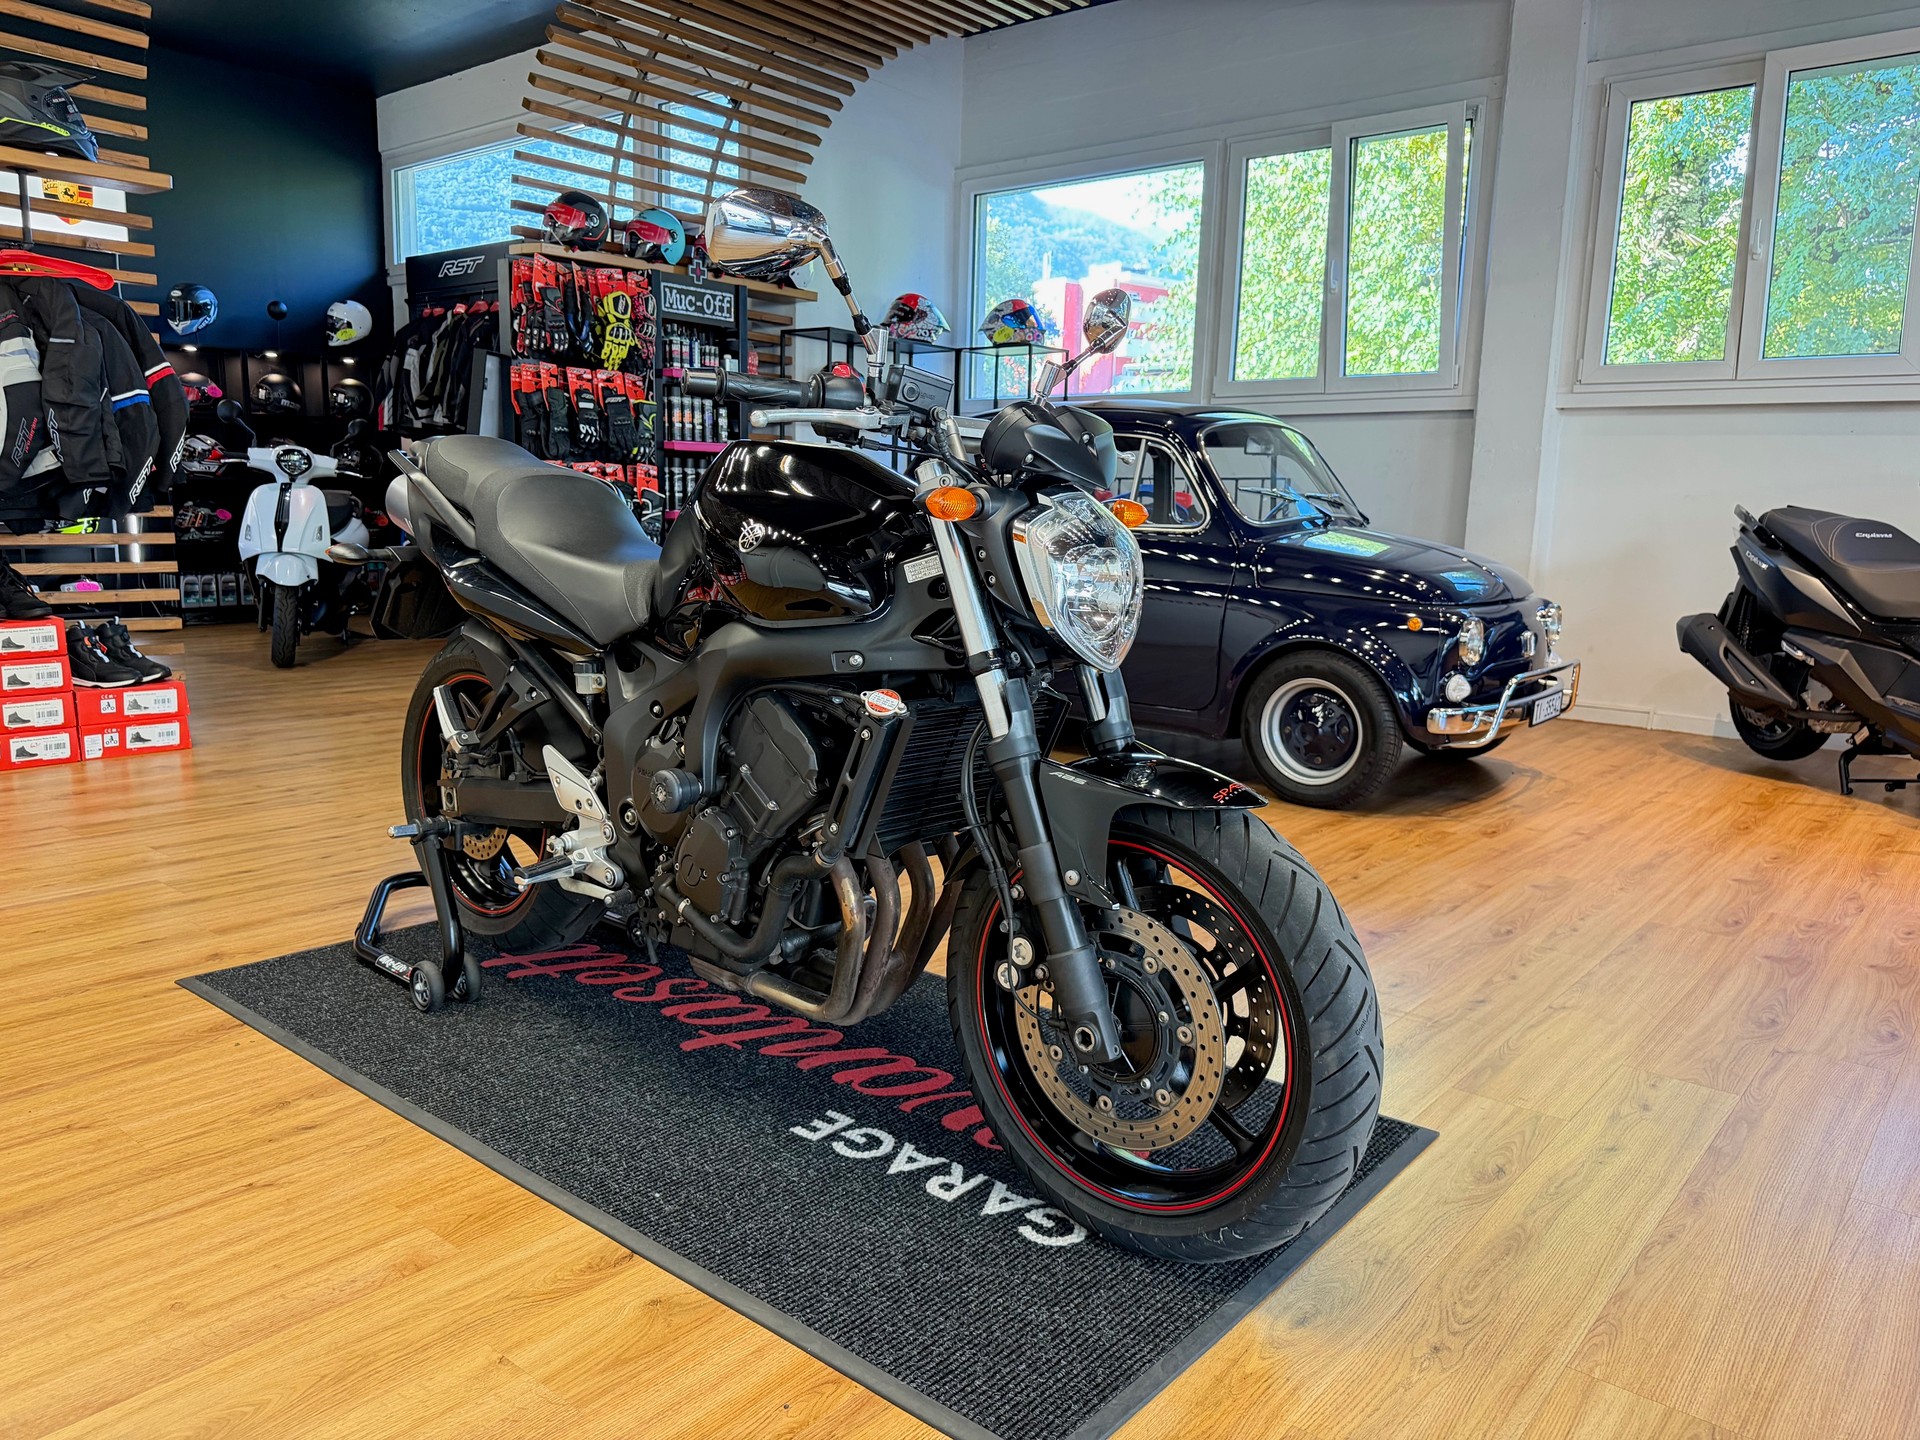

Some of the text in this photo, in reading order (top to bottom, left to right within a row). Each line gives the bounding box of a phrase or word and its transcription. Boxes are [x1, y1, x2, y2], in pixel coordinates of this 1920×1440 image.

[438, 255, 486, 278] RST
[664, 287, 731, 318] Muc-Off
[11, 416, 31, 468] RST
[169, 426, 187, 474] RS
[129, 455, 153, 505] RST
[790, 1109, 1088, 1247] GARAGE
